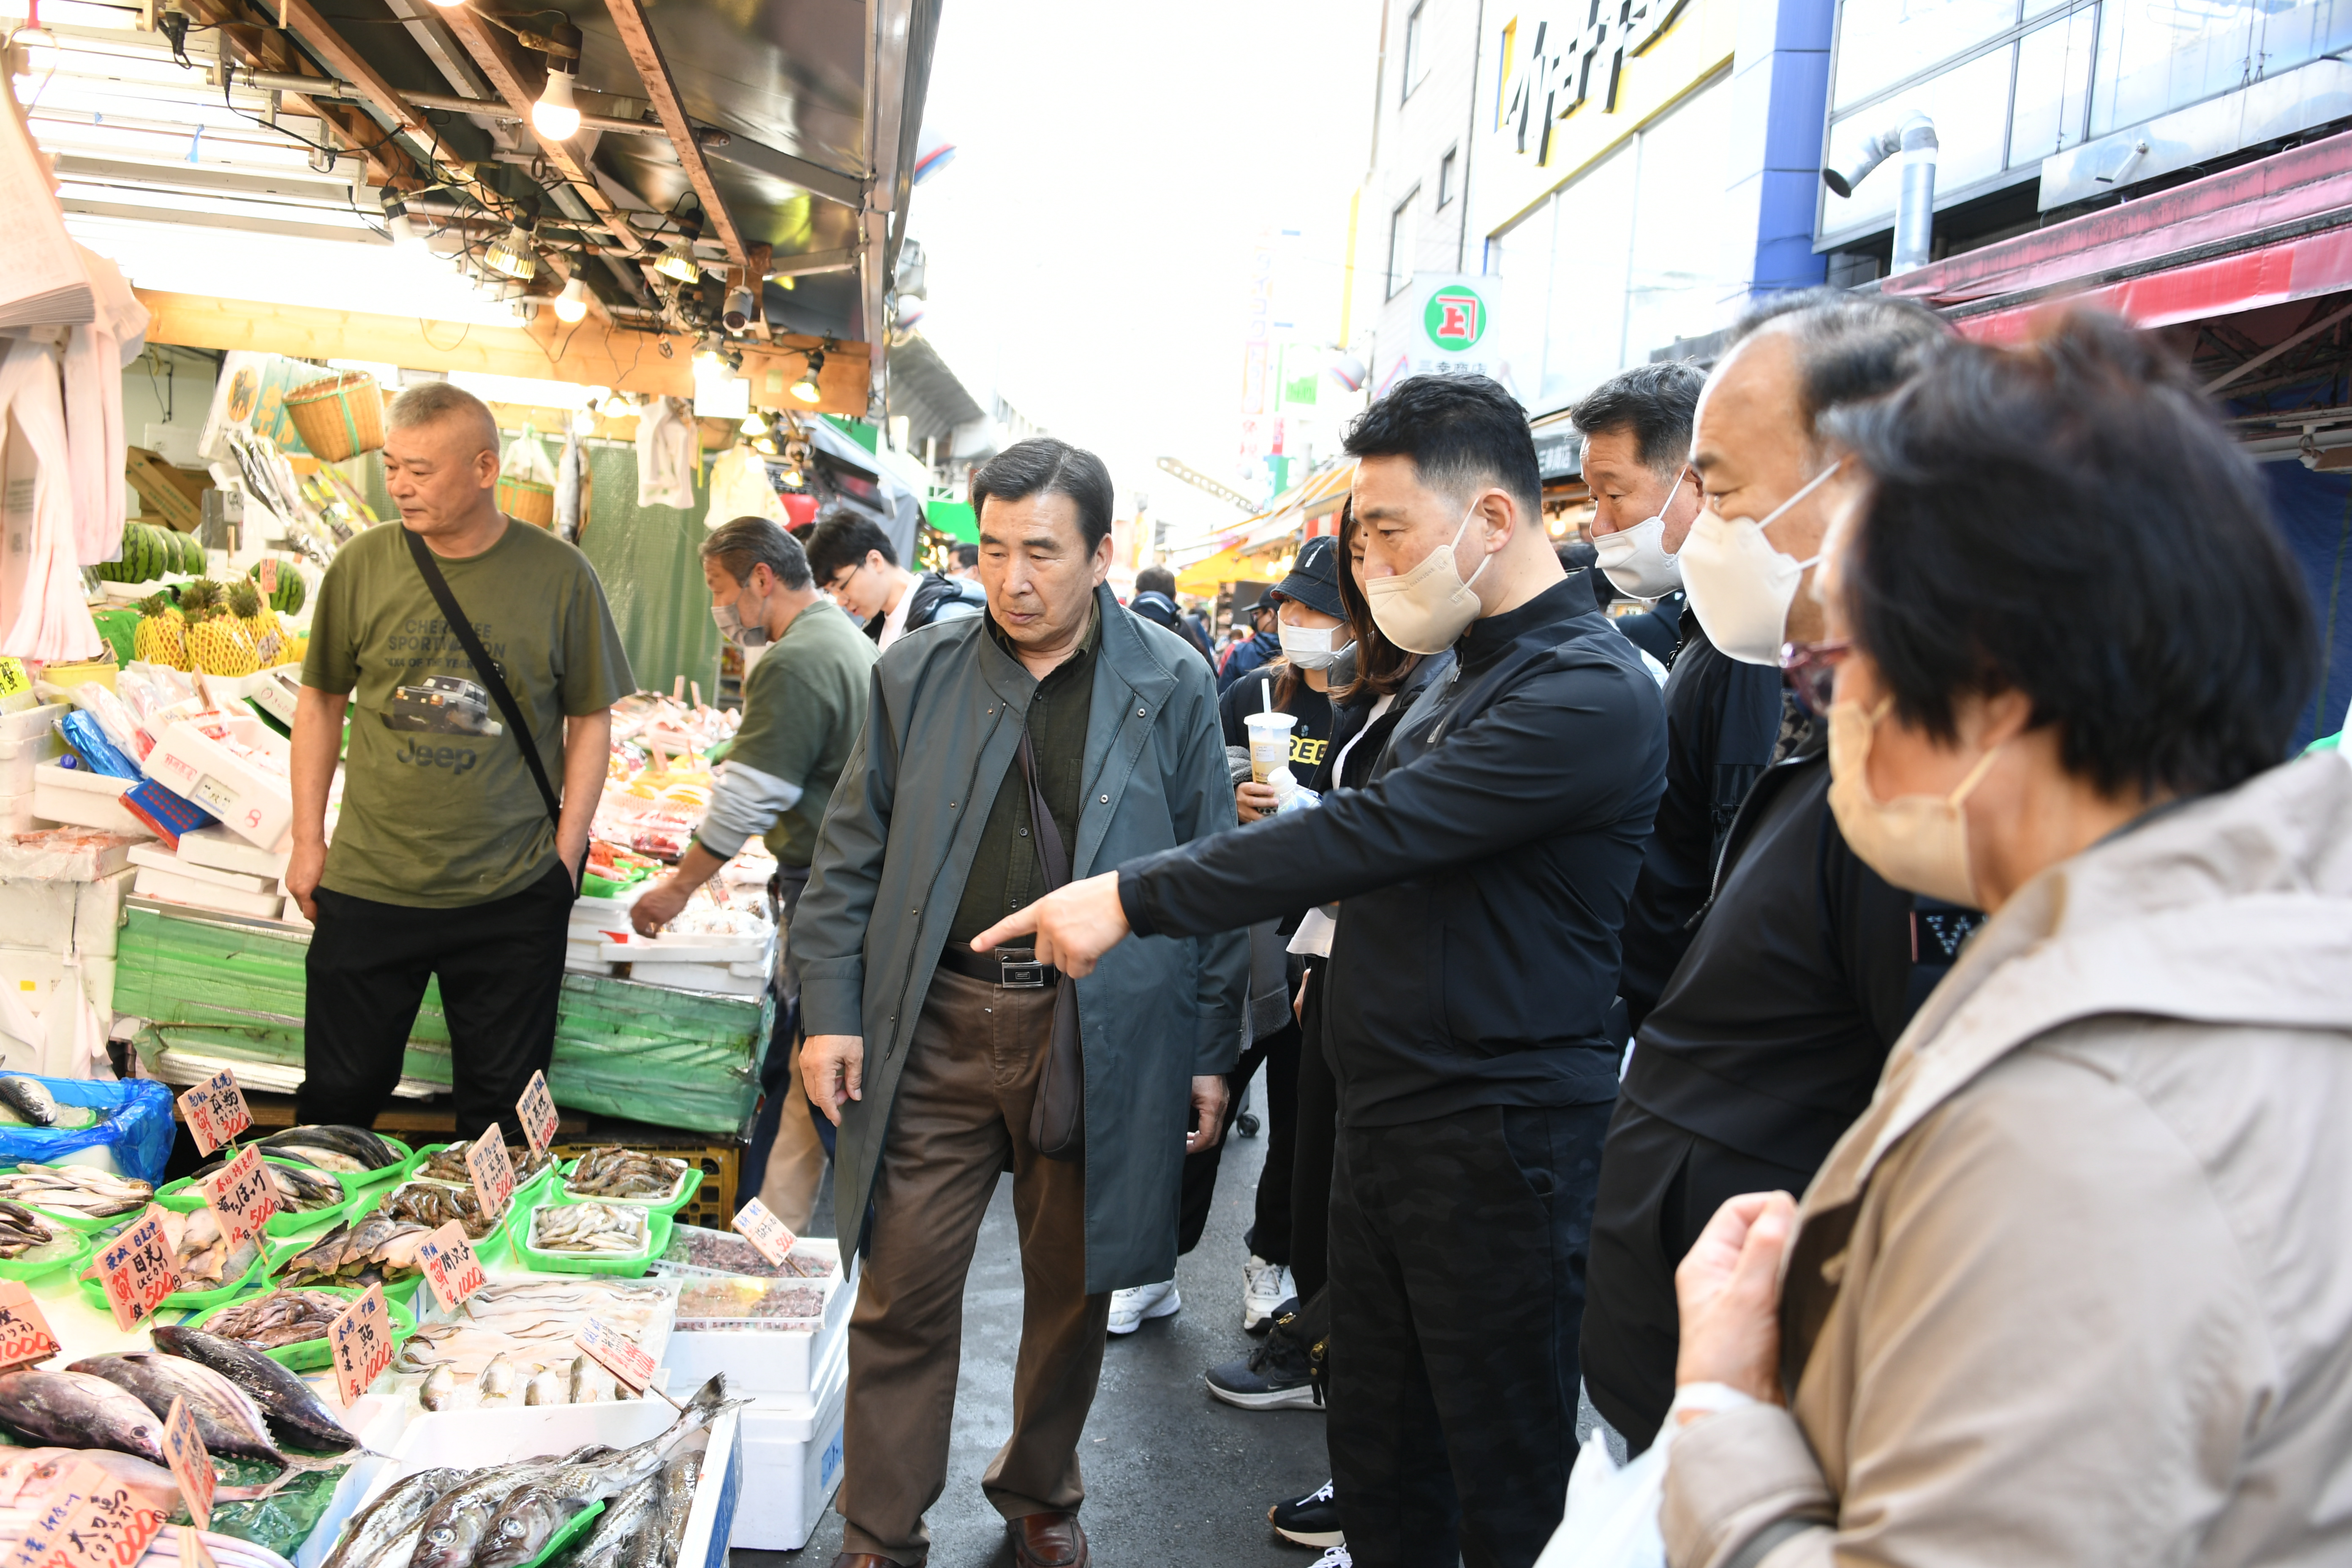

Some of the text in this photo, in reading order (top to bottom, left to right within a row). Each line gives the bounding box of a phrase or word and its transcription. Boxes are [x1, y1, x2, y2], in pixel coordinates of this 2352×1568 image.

[405, 619, 491, 638] CHEREE
[408, 658, 423, 667] OF
[397, 737, 476, 774] Jeep
[188, 1091, 208, 1107] 鳥取
[221, 1111, 253, 1139] 300円
[250, 1197, 281, 1230] 500円
[106, 1245, 131, 1271] 茨城
[132, 1243, 163, 1273] 目光
[421, 1242, 438, 1261] 韓国
[112, 1267, 135, 1306] 鮮
[144, 1271, 182, 1310] 500円
[361, 1297, 376, 1318] 中国
[358, 1323, 374, 1349] 鮎
